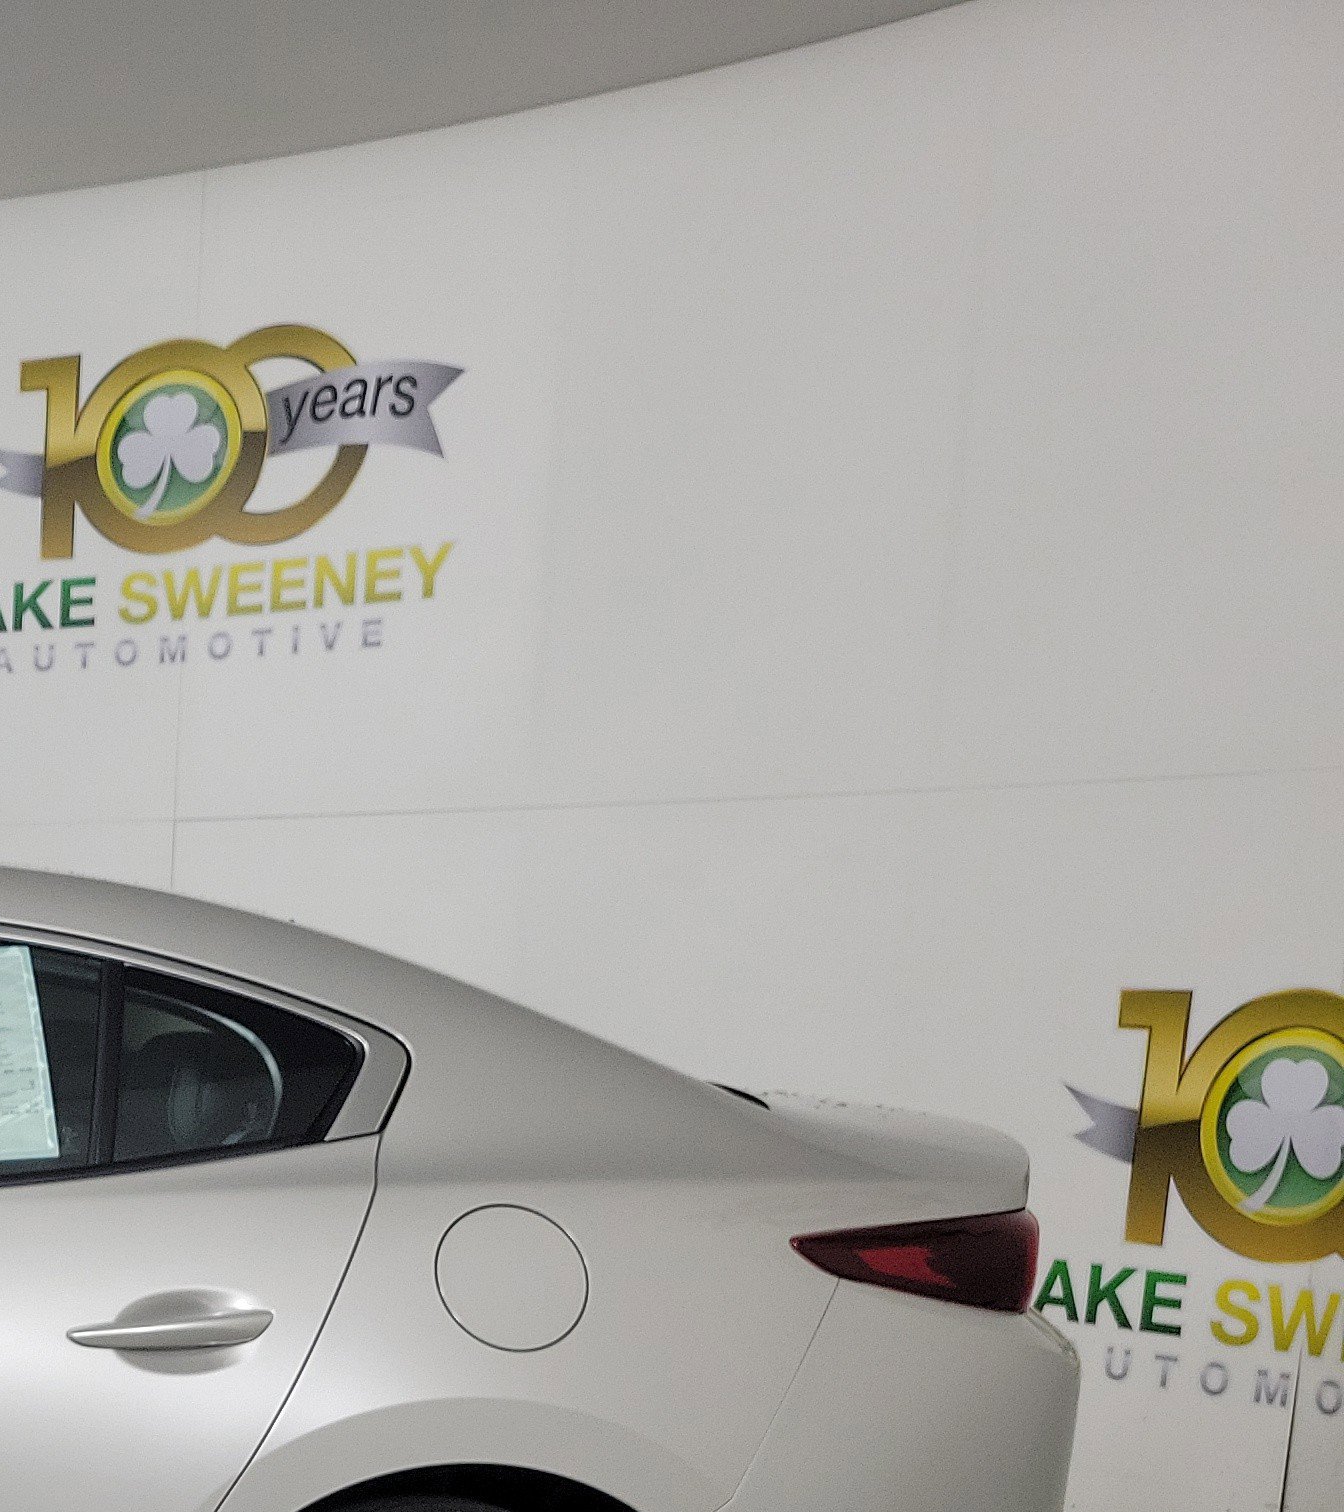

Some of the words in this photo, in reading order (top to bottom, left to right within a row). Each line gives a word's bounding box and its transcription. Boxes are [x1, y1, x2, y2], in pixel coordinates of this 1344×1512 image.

[278, 372, 418, 444] years
[118, 541, 455, 626] SWEENEY
[1118, 988, 1344, 1264] 10
[1033, 1259, 1188, 1337] AKE
[1211, 1279, 1344, 1364] SW
[1105, 1345, 1343, 1415] UTOMO
